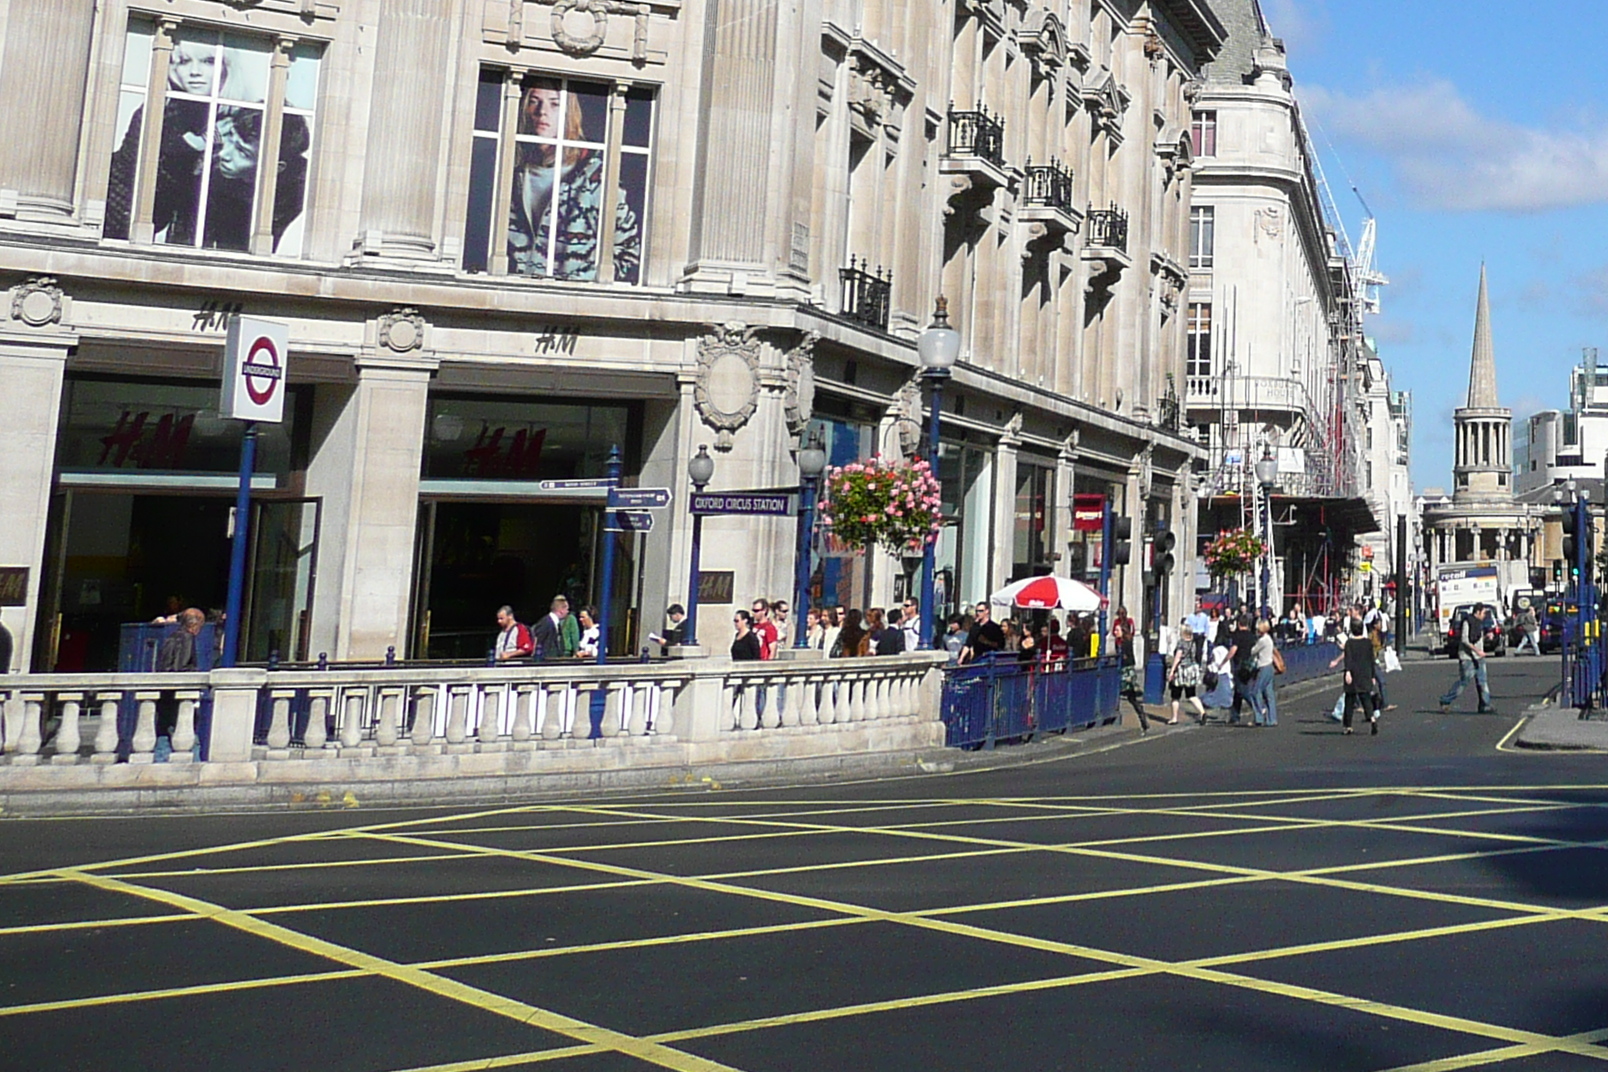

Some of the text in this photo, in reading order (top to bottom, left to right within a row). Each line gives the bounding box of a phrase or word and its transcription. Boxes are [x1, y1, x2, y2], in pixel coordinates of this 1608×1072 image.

[535, 325, 580, 356] H&M
[695, 497, 785, 511] OXFORD CIRCUS STATION
